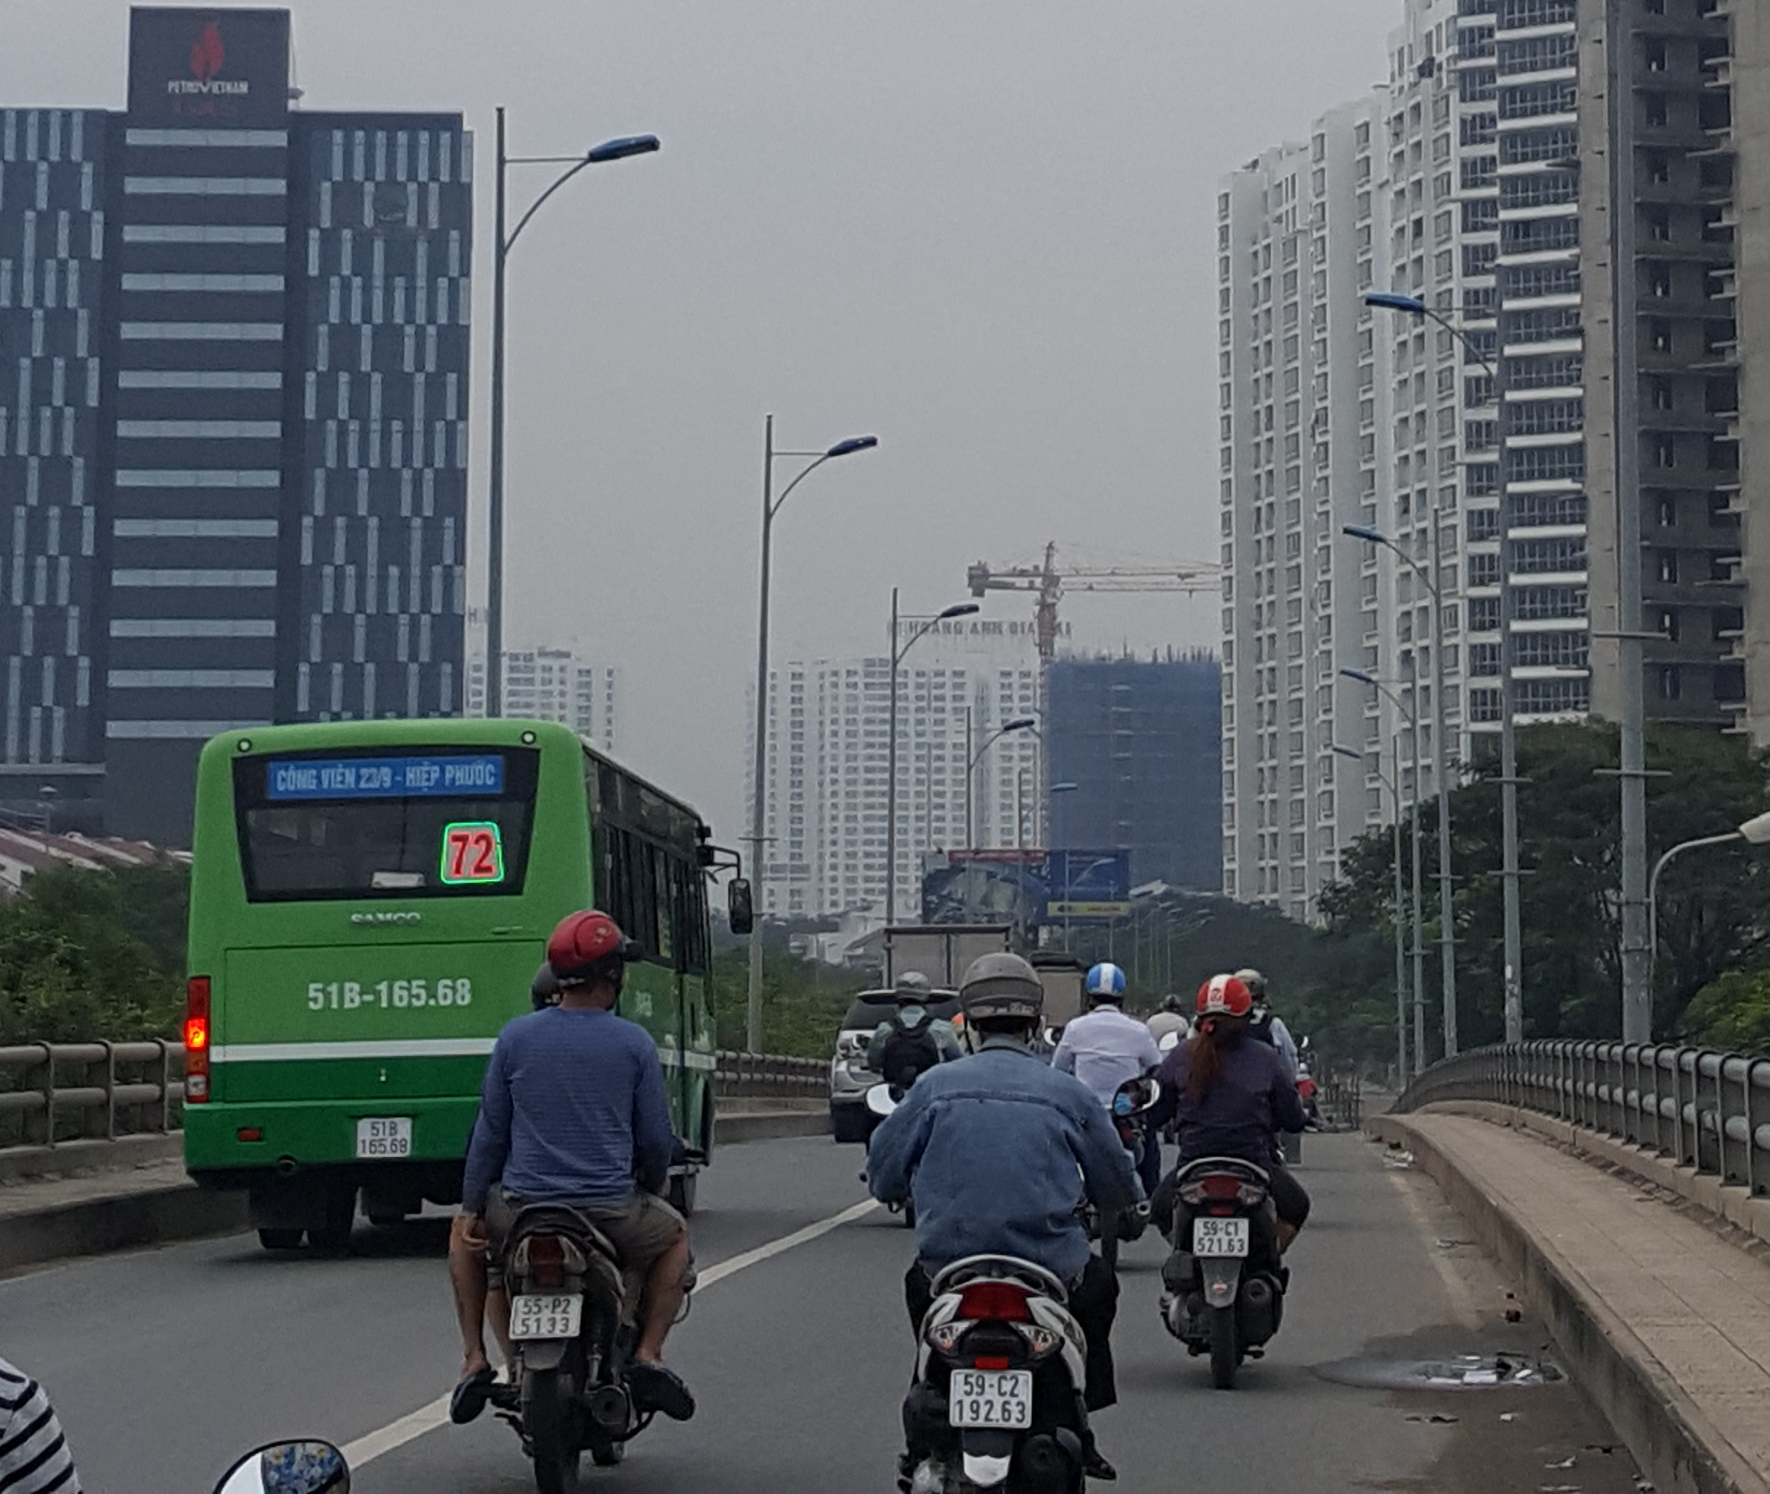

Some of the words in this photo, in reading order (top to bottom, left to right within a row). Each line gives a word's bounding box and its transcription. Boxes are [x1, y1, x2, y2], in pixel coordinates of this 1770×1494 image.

[450, 832, 495, 875] 72
[308, 978, 472, 1010] 51B-165.68
[370, 1121, 398, 1137] 51B
[963, 1374, 1020, 1398] 59-C2
[955, 1399, 1026, 1423] 192.63
